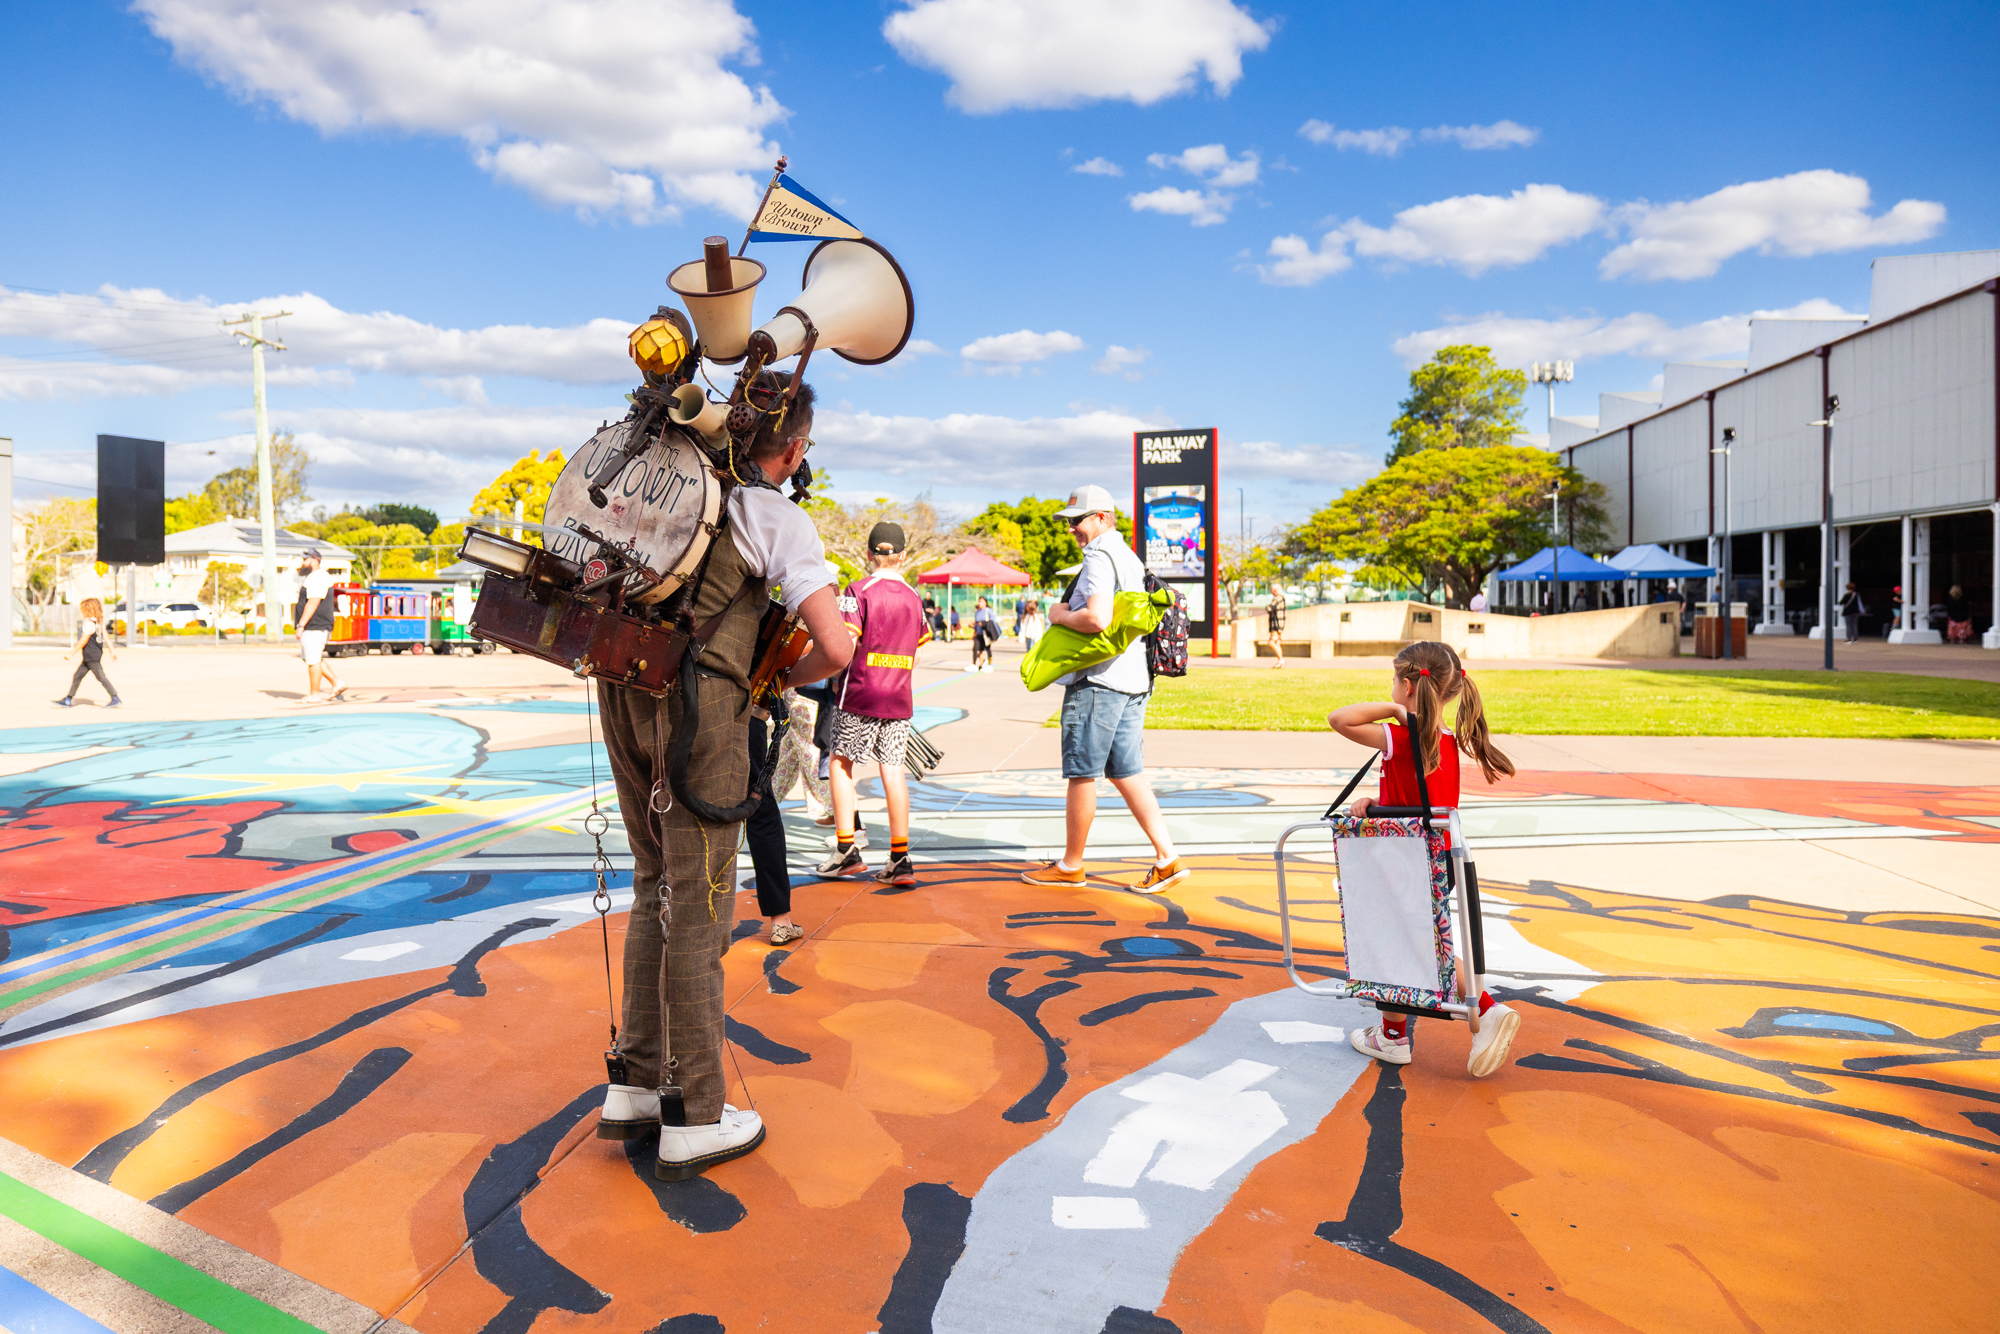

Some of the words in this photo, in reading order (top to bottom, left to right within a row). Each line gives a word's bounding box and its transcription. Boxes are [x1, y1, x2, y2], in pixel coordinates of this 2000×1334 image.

[762, 212, 818, 234] Brown!
[1142, 435, 1207, 450] RAILWAY
[1142, 450, 1182, 464] PARK
[1146, 539, 1167, 547] LOTS
[585, 565, 605, 580] RCA
[873, 654, 908, 662] NATIONAL
